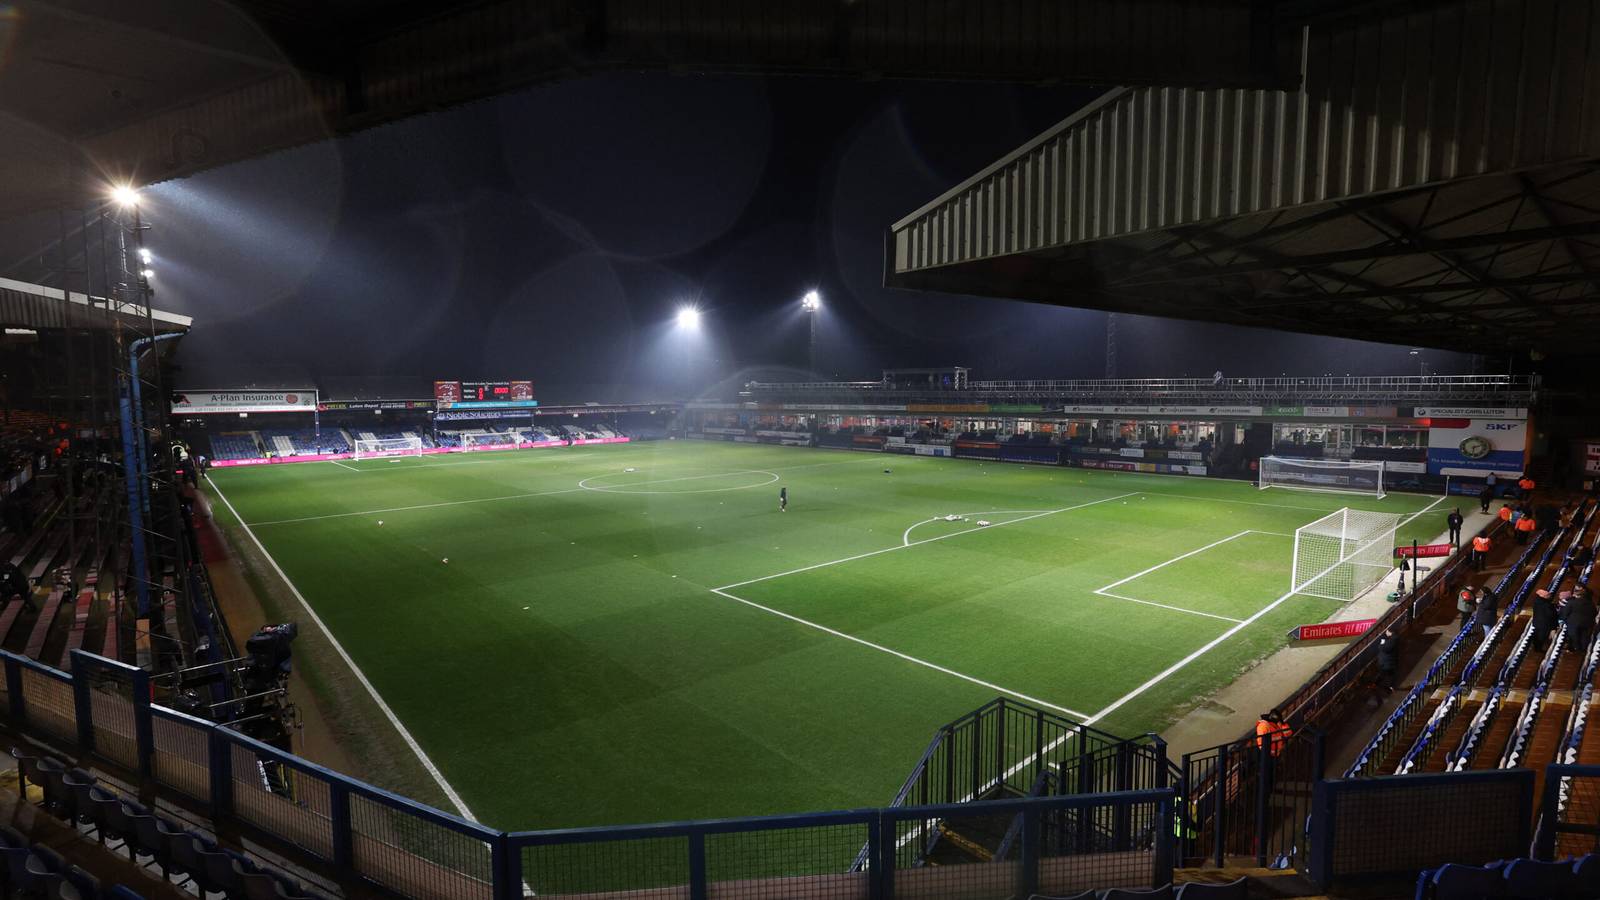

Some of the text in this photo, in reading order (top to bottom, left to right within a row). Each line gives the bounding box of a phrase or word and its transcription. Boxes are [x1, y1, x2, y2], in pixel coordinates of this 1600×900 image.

[211, 394, 284, 402] A-Plan Insurance
[1485, 423, 1517, 431] SKF
[1303, 626, 1343, 638] Emirates
